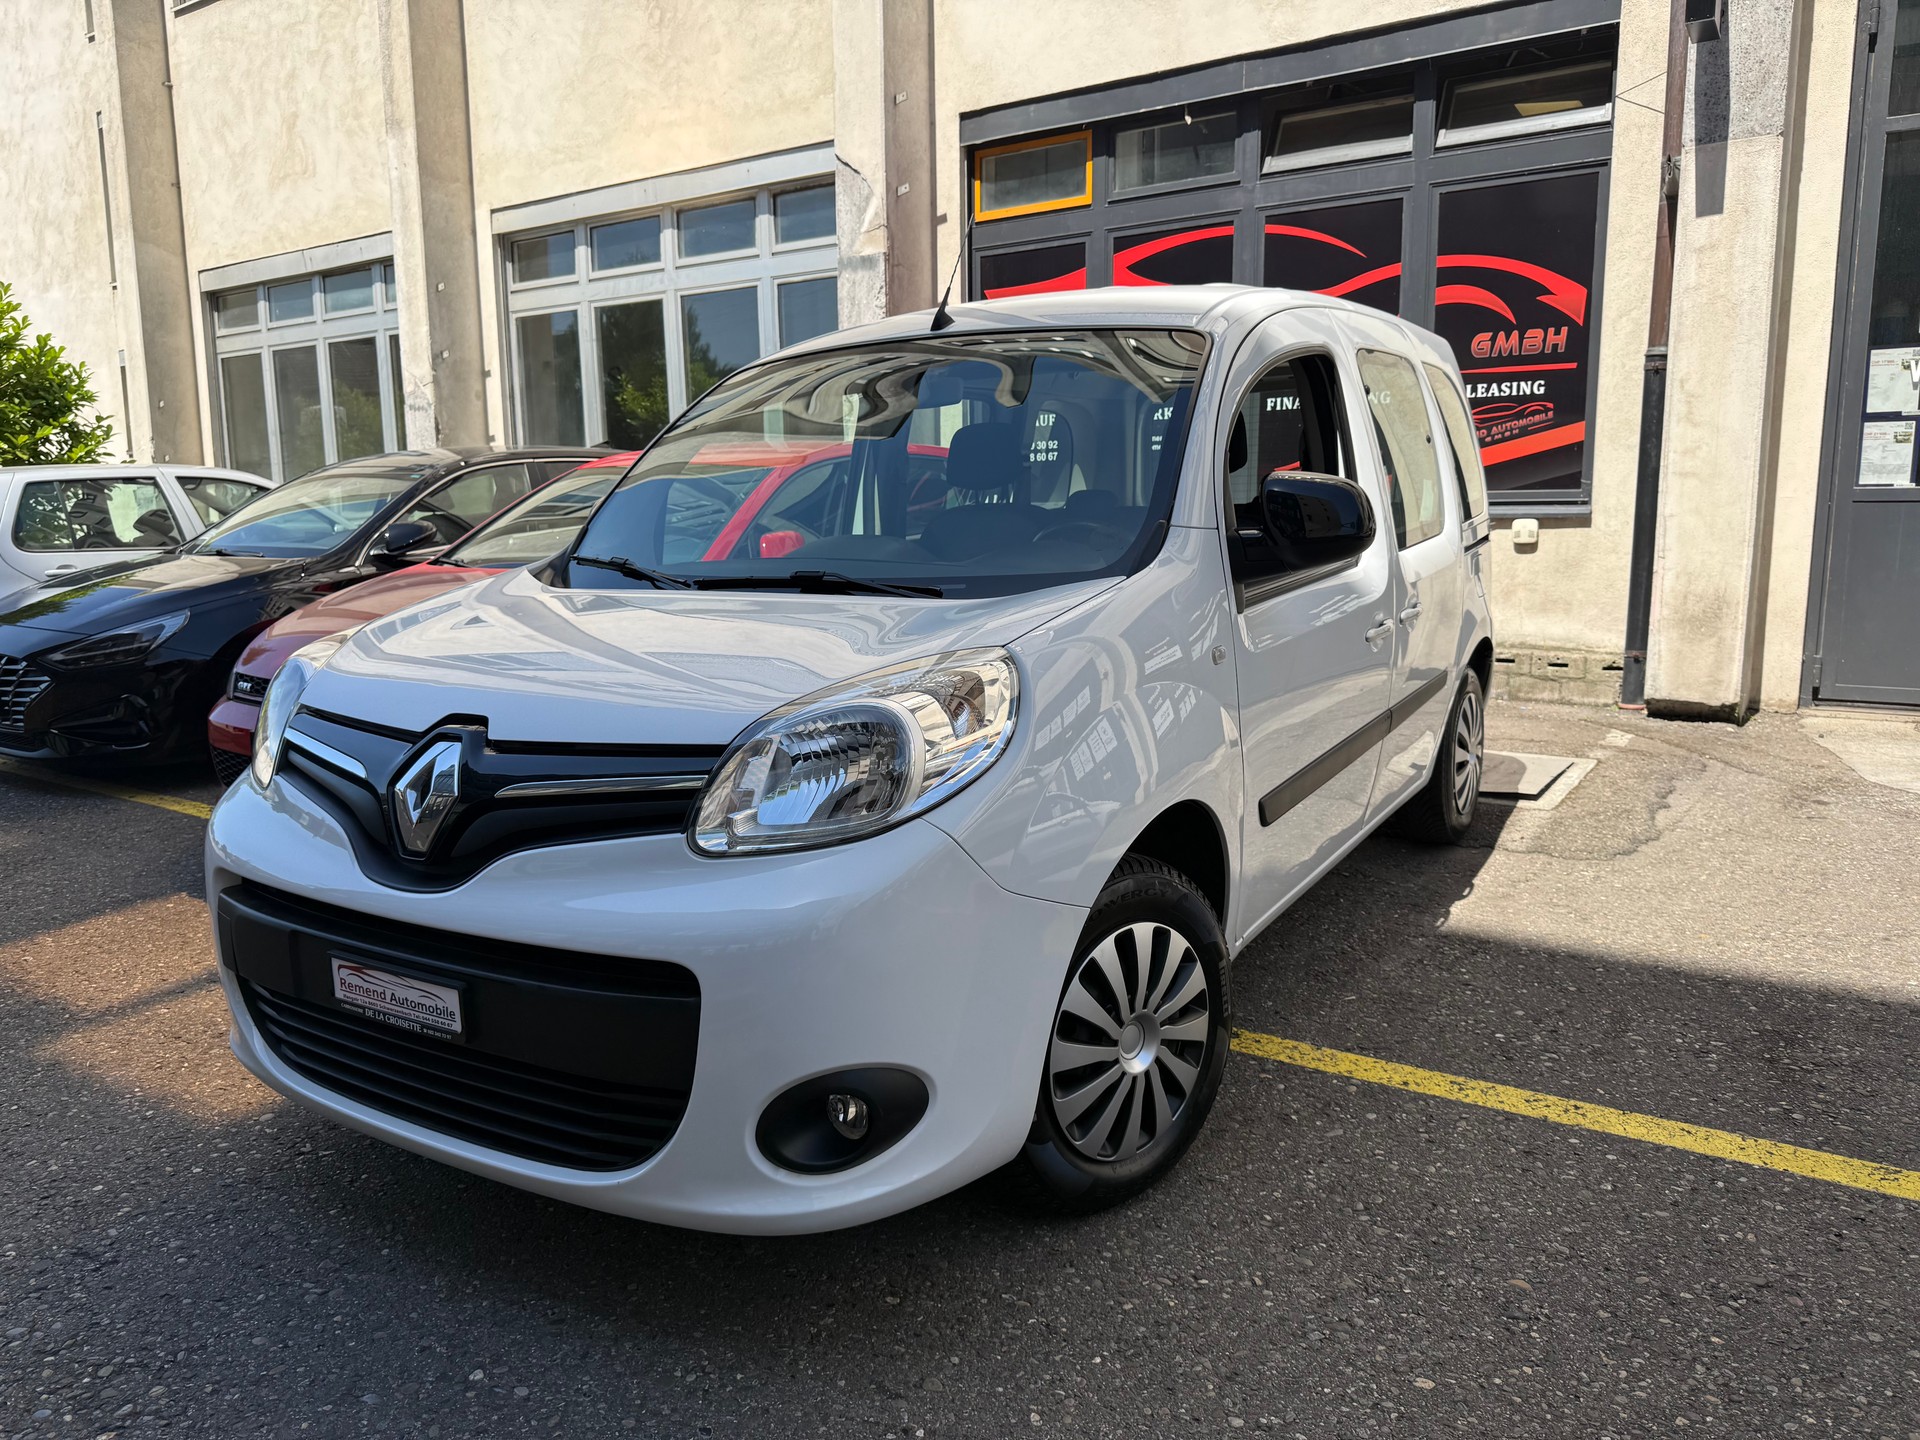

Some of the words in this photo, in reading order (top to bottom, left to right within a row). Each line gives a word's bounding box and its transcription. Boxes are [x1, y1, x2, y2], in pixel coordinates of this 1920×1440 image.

[1470, 326, 1568, 358] GMBH
[1466, 380, 1546, 398] LEASING
[1491, 410, 1554, 435] AUTOMOBILE
[1036, 440, 1047, 450] 30
[1047, 440, 1058, 450] 92
[1036, 452, 1047, 462] 60
[1047, 451, 1058, 461] 67
[340, 977, 387, 1000] Remend
[389, 992, 456, 1019] Automobile
[365, 1008, 375, 1018] DE
[375, 1011, 385, 1022] LA
[385, 1013, 422, 1033] CROISETTE
